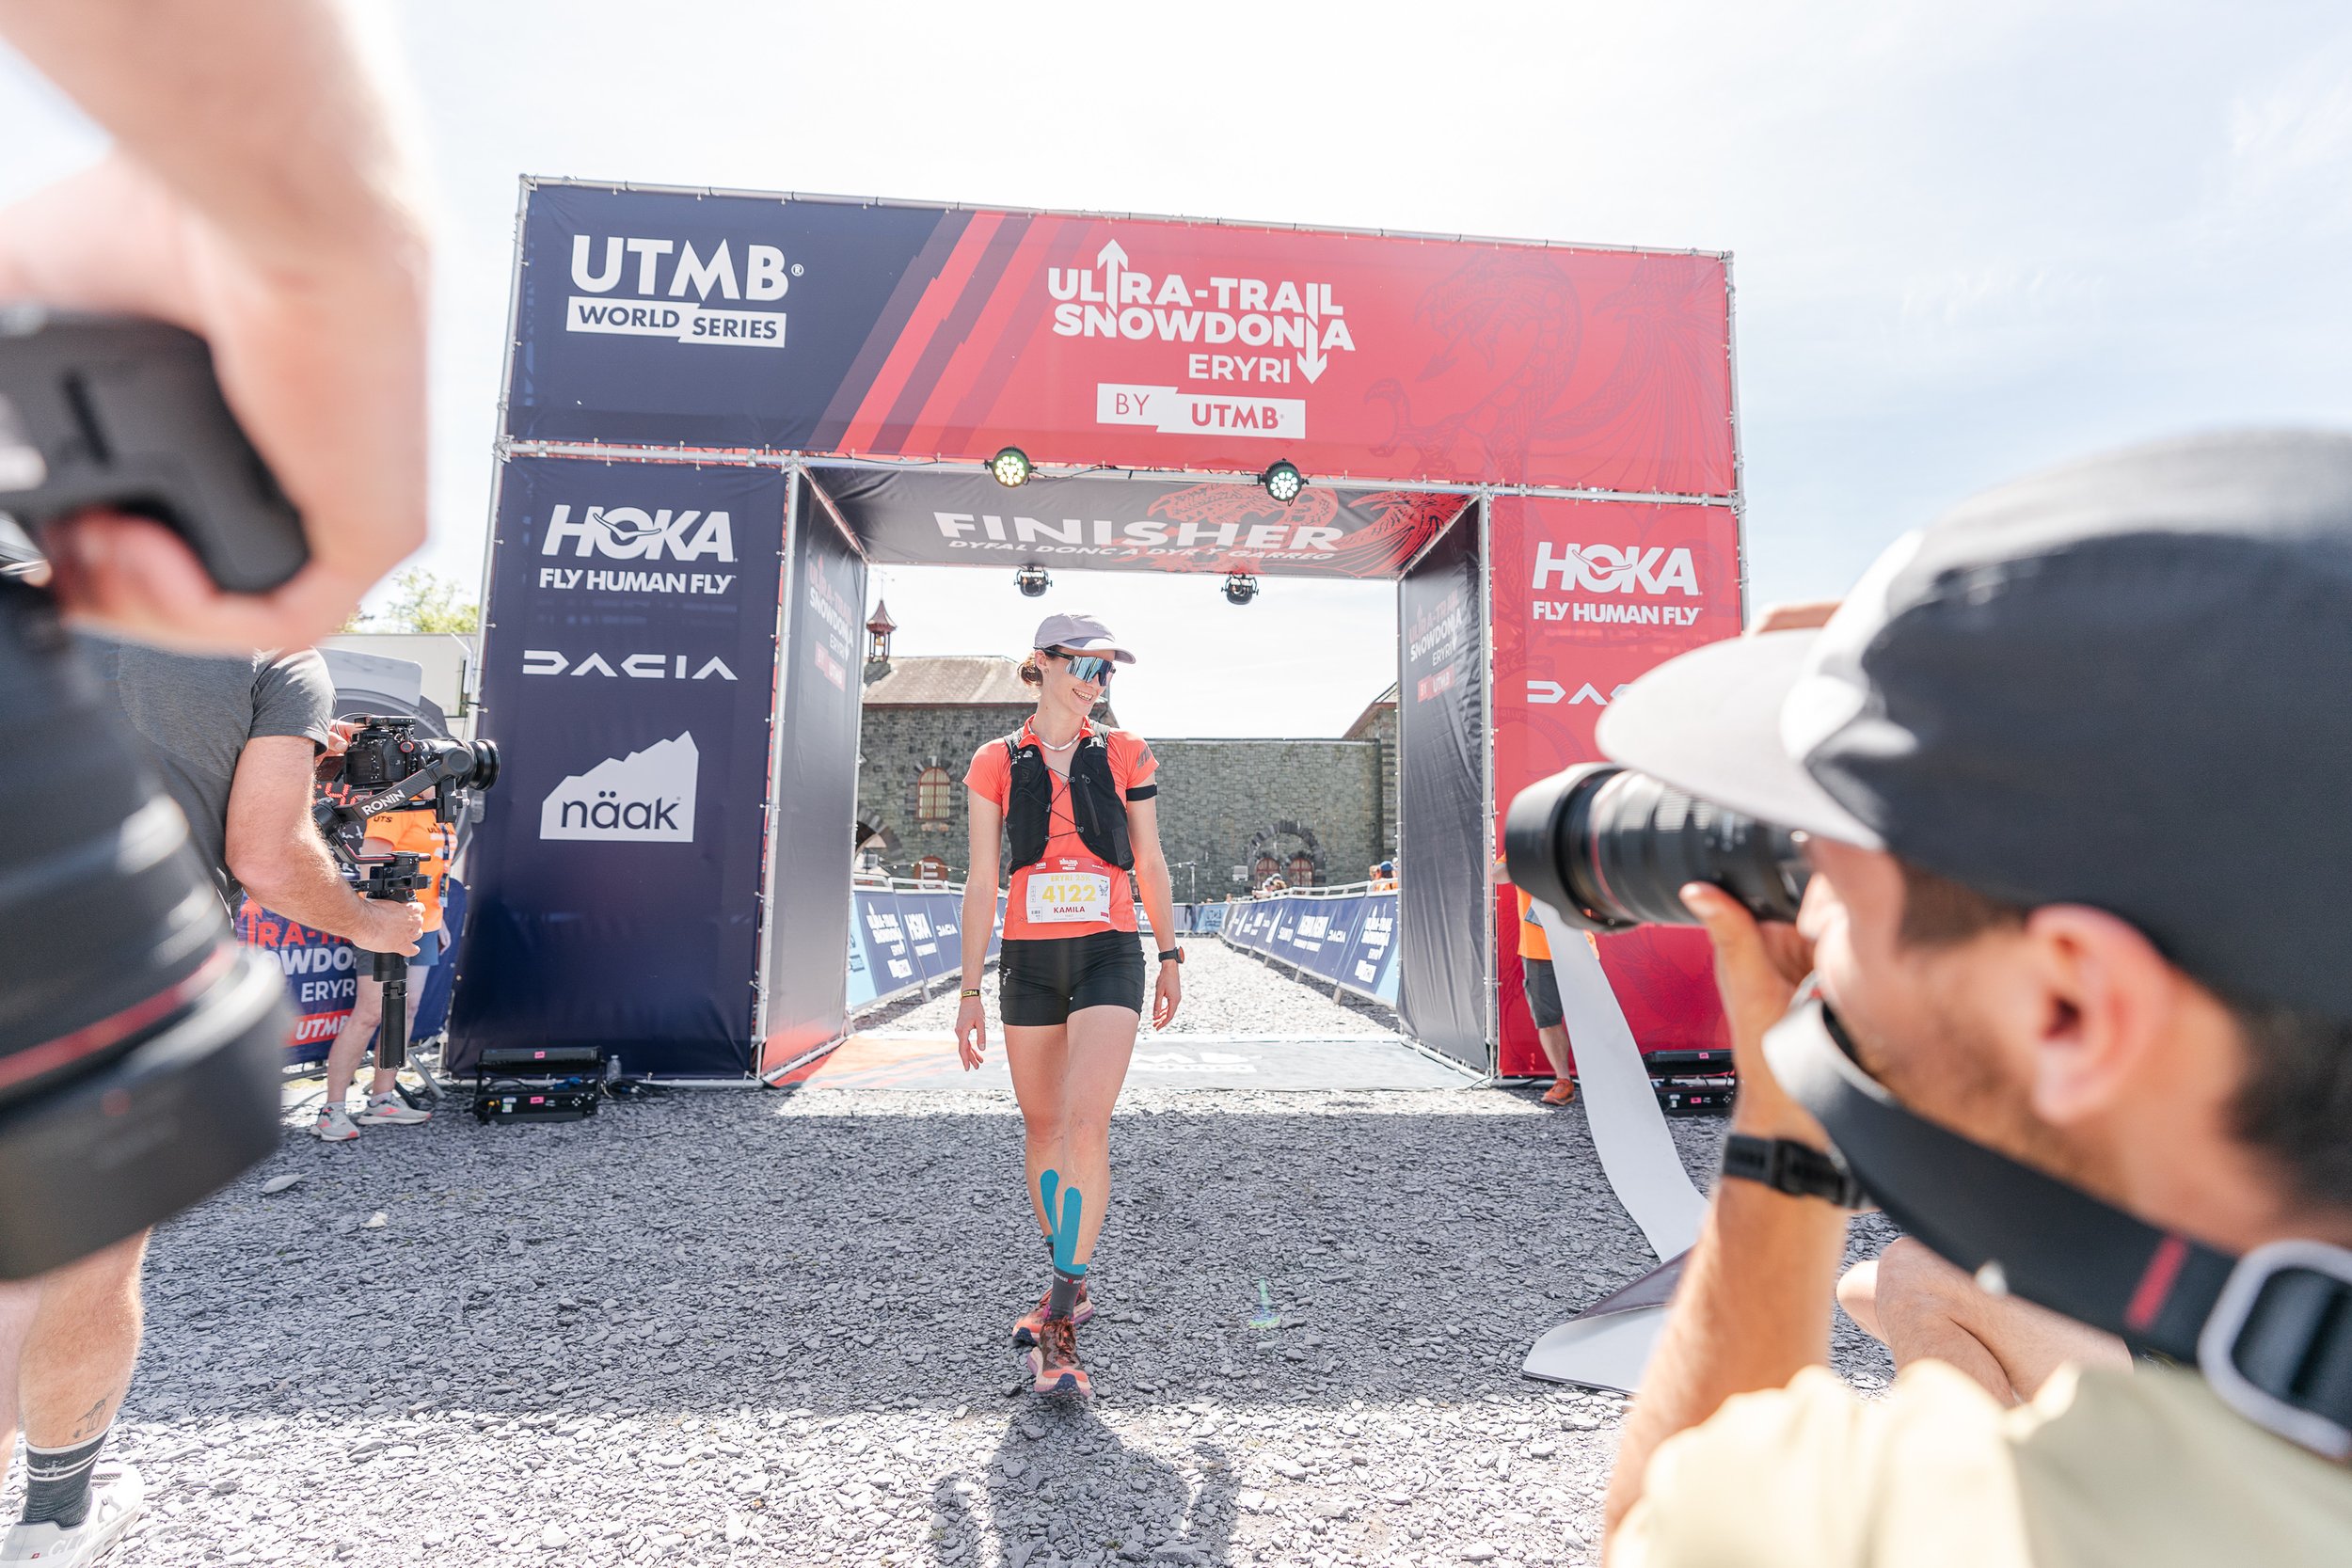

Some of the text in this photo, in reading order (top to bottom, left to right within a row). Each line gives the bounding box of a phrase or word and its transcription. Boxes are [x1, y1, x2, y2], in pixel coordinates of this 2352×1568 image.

[1047, 254, 1343, 322] ULTRA-TRAIL
[579, 305, 777, 340] WORLD SERIES
[1052, 303, 1356, 369] SNOWDONIA
[1188, 353, 1291, 384] ERYRI
[1116, 393, 1150, 416] BY
[541, 504, 738, 562] HOKA
[933, 511, 1343, 551] FINISHER
[948, 540, 1028, 551] DYFAL
[1035, 545, 1117, 556] DONC
[1229, 550, 1334, 560] GARREG
[539, 567, 733, 594] FLY HUMAN FLY
[1532, 542, 1702, 596] HOKA
[1533, 600, 1699, 626] FLY HUMAN FLY
[523, 649, 739, 680] DACIA
[361, 788, 406, 816] RONIN
[1041, 884, 1097, 903] 4122
[301, 978, 356, 1003] ERYR
